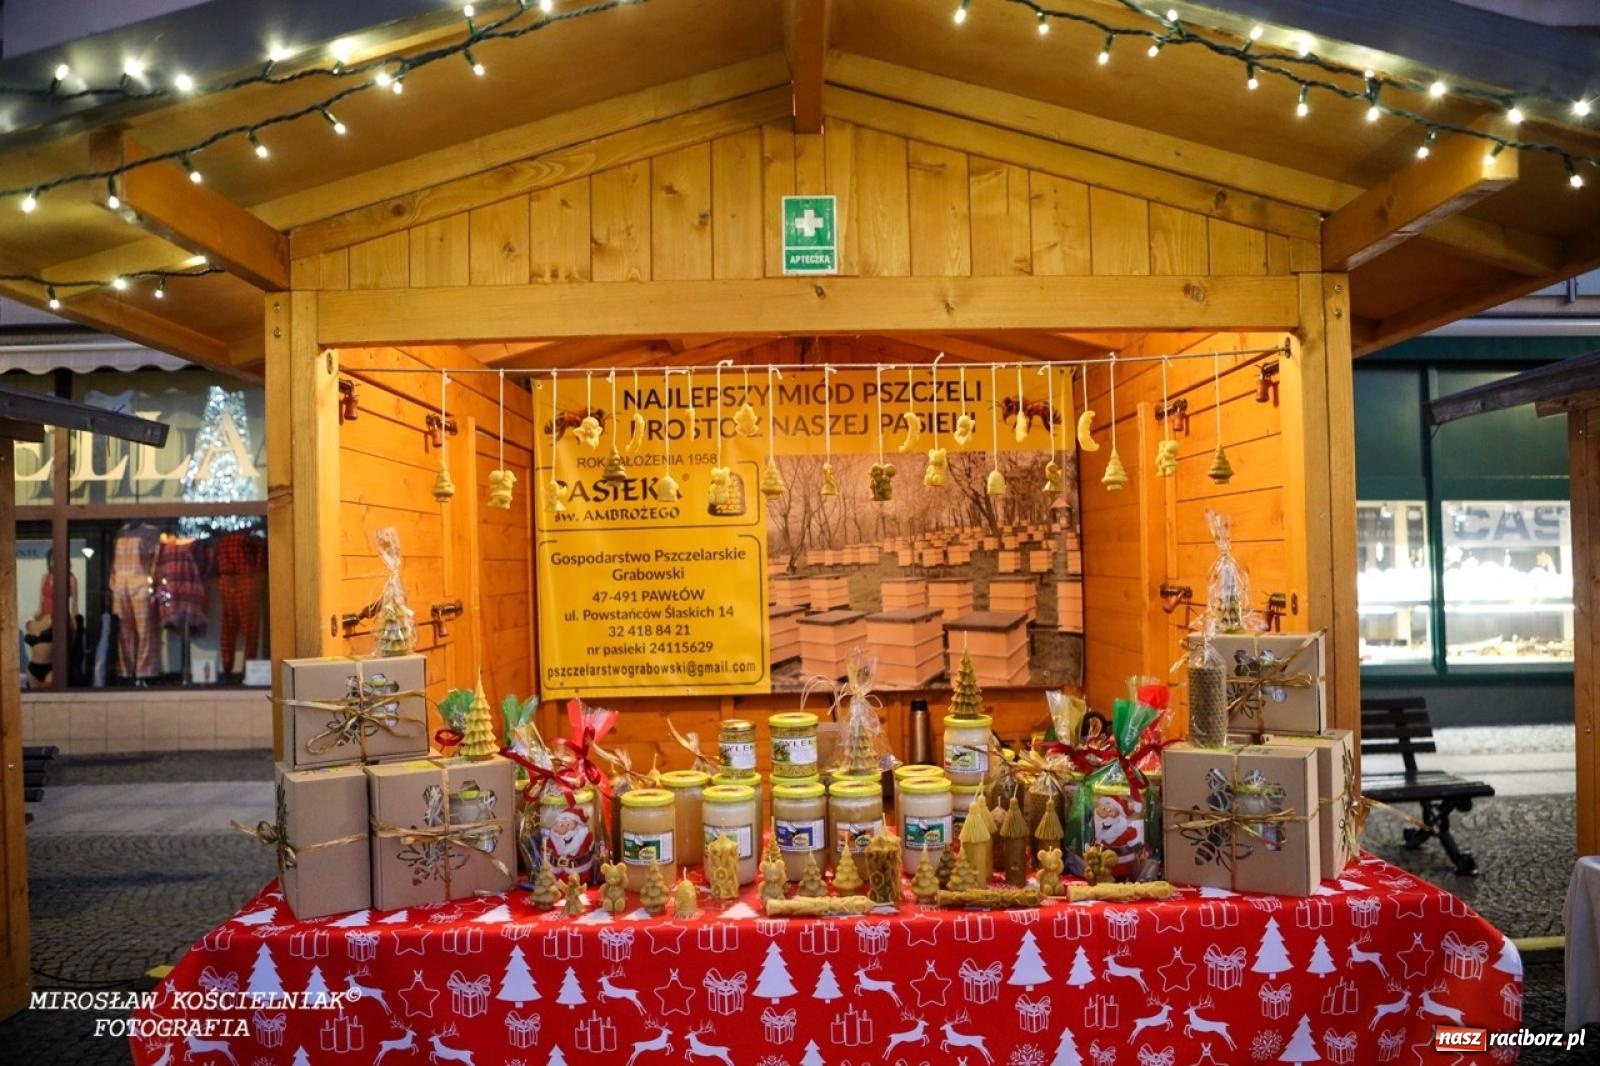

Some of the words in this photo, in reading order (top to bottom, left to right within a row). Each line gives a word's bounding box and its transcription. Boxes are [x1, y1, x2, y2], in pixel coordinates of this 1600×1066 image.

[789, 255, 831, 265] APTECZKA
[623, 385, 769, 410] NAJLEPSZY
[778, 377, 854, 406] MIÓD
[863, 380, 982, 404] PSZCZELI
[772, 413, 868, 437] NASZEJ
[577, 458, 606, 469] ROK
[608, 454, 683, 467] AŁOŻENIA
[688, 453, 717, 465] 1958
[555, 476, 683, 503] ASIEK
[583, 506, 680, 521] AMBROŻEGO
[550, 552, 650, 566] Gospodarstwo
[654, 547, 746, 563] Pszczelarskie
[612, 567, 685, 582] Grabowski
[592, 591, 637, 602] 47-491
[641, 587, 705, 601] PAWŁÓW
[564, 609, 579, 621] ul.
[583, 608, 661, 621] Powstańców
[719, 606, 734, 617] 14
[608, 626, 624, 637] 32
[628, 625, 652, 636] 418
[655, 625, 671, 635] 84
[675, 624, 690, 635] 21
[586, 646, 599, 656] nr
[603, 642, 646, 656] pasieki
[649, 641, 713, 653] 24115629
[547, 661, 756, 681] pszczelarstwograbowski@gmail.com
